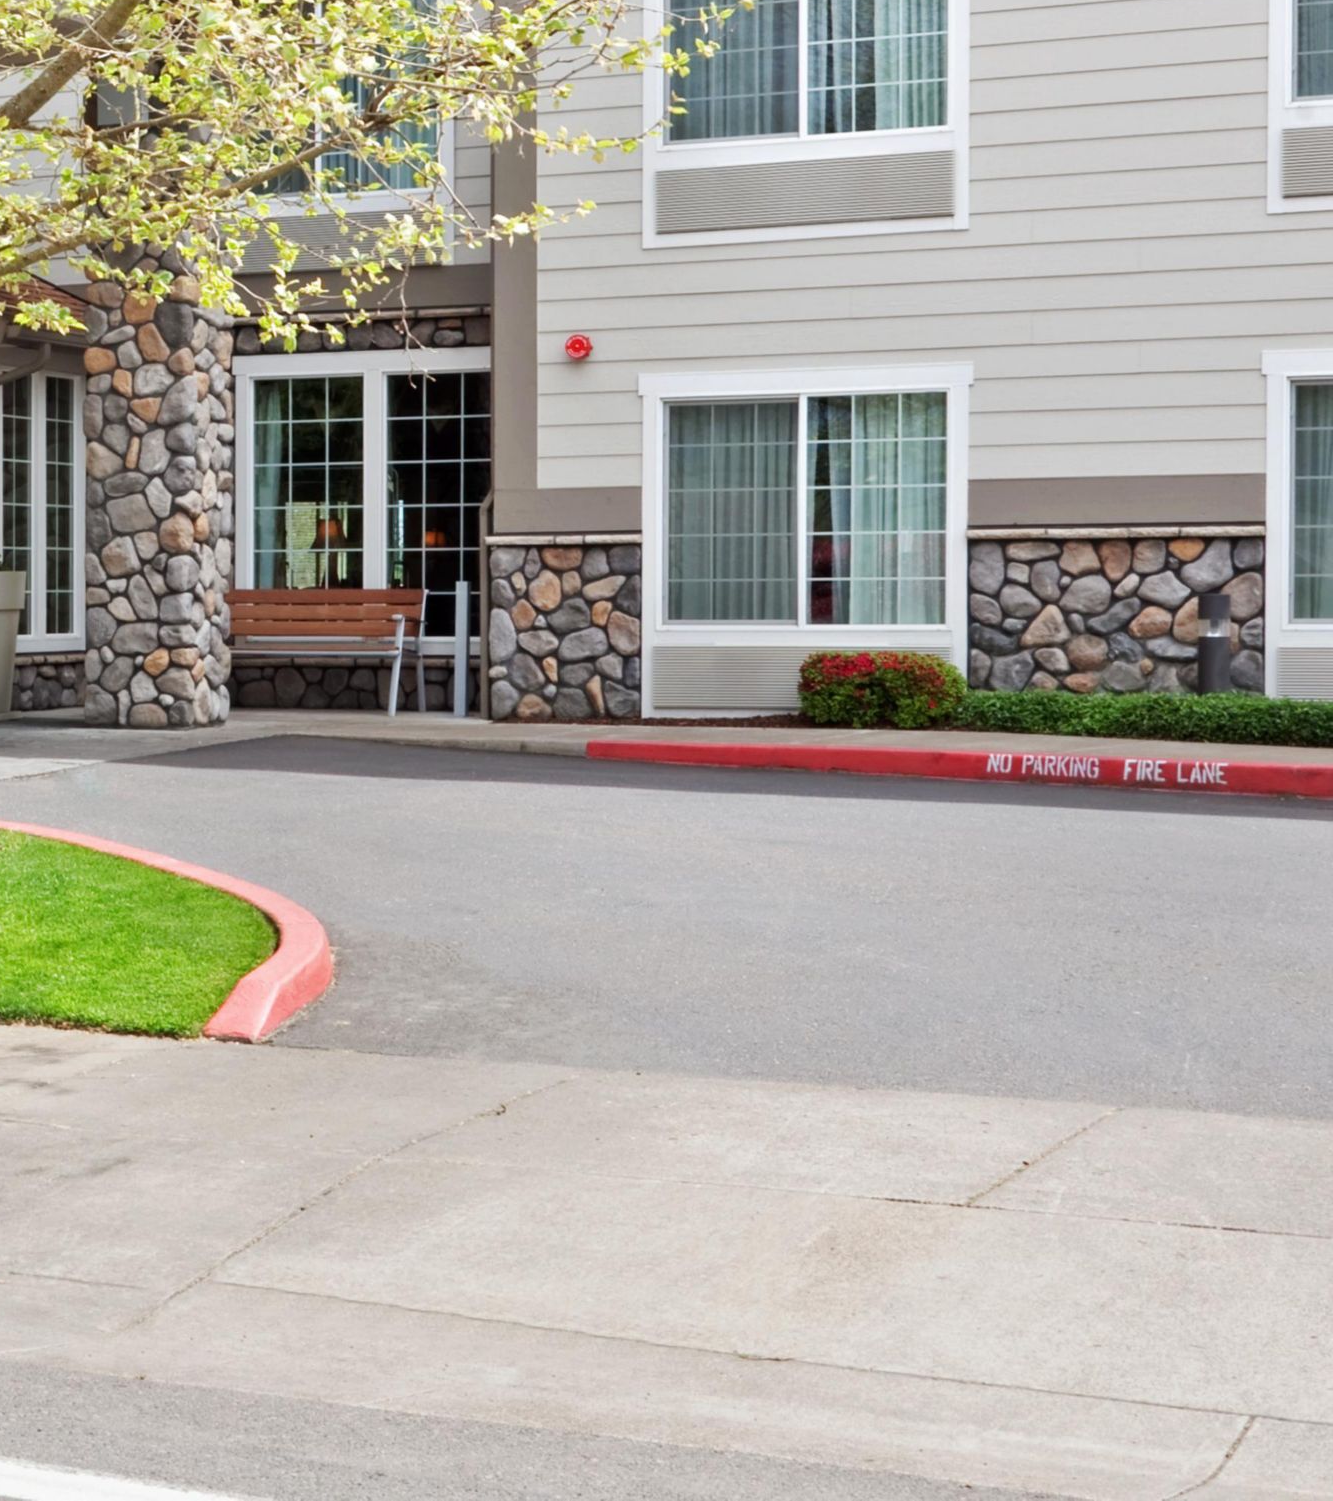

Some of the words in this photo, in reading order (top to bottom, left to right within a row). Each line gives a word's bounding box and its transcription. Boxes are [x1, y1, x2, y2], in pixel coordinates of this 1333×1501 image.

[986, 753, 1013, 774] NO
[1021, 753, 1100, 780] PARKING
[1122, 758, 1168, 783] FIRE
[1176, 761, 1230, 786] LANE
